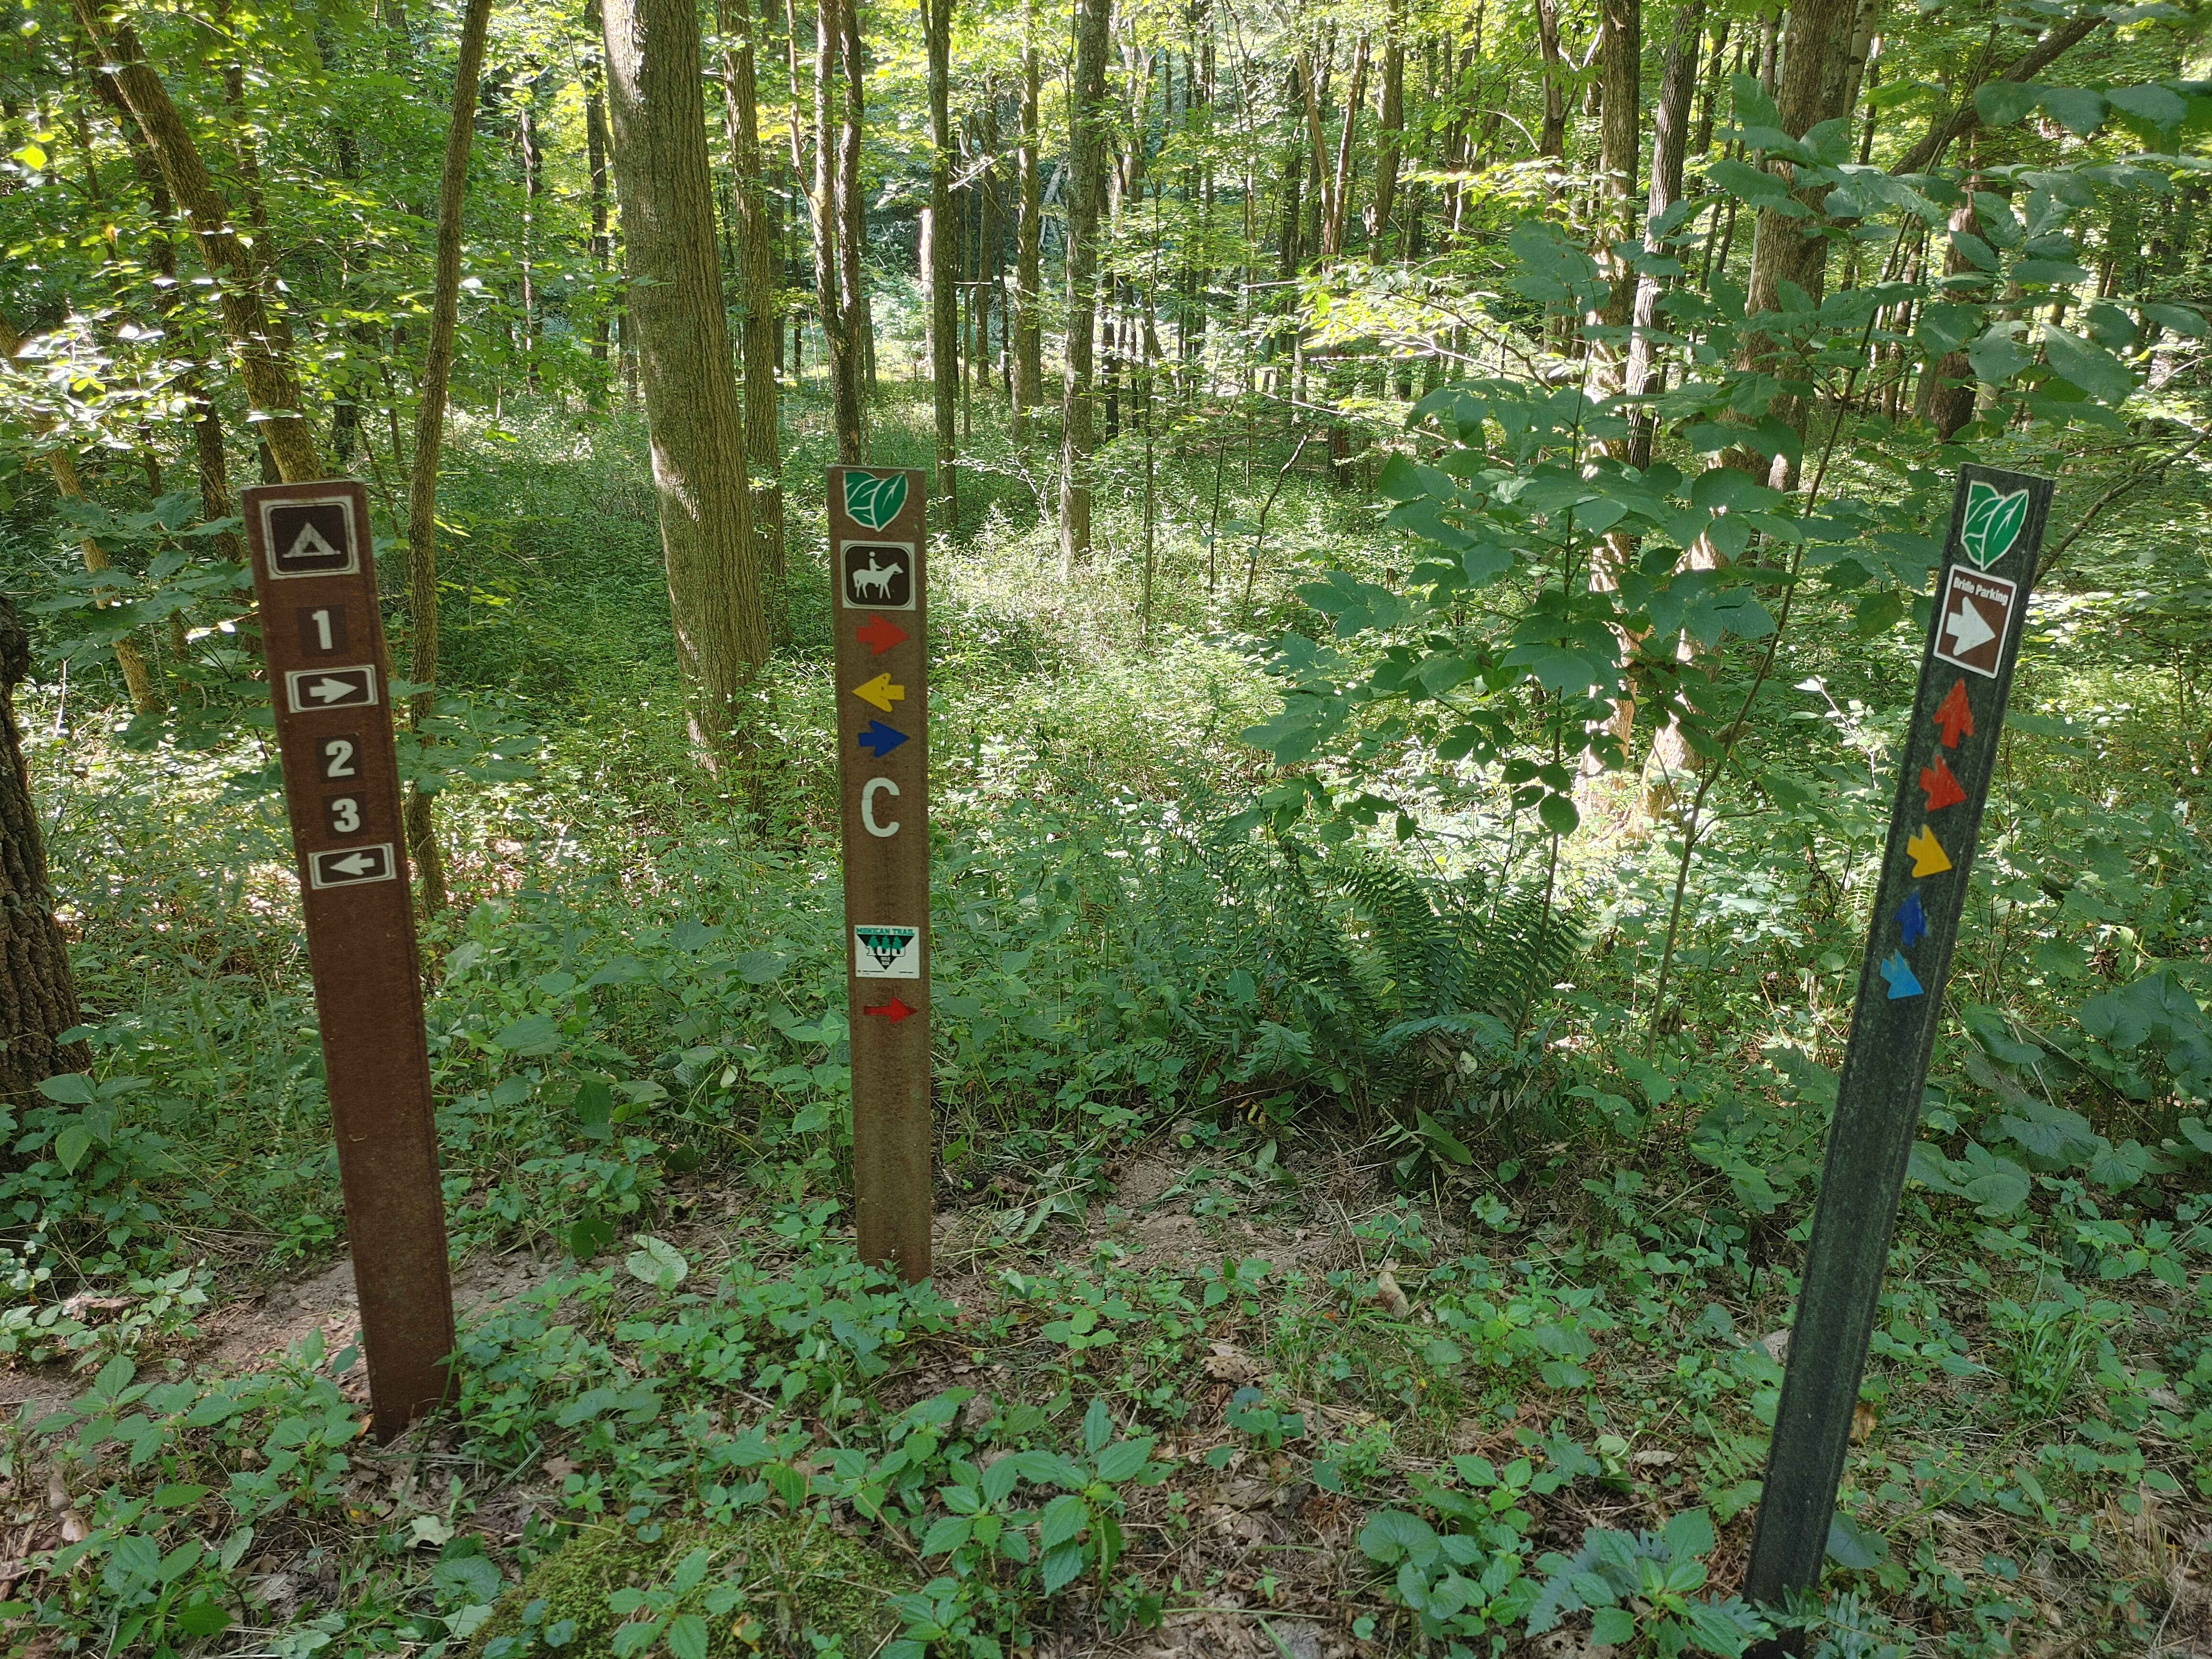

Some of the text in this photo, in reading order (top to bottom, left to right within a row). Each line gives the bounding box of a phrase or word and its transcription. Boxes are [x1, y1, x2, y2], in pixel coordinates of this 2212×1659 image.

[1953, 577, 2008, 606] Bridle Parking
[311, 609, 333, 650] 1
[325, 740, 355, 778] 2
[332, 798, 361, 833] 3
[861, 777, 900, 838] C
